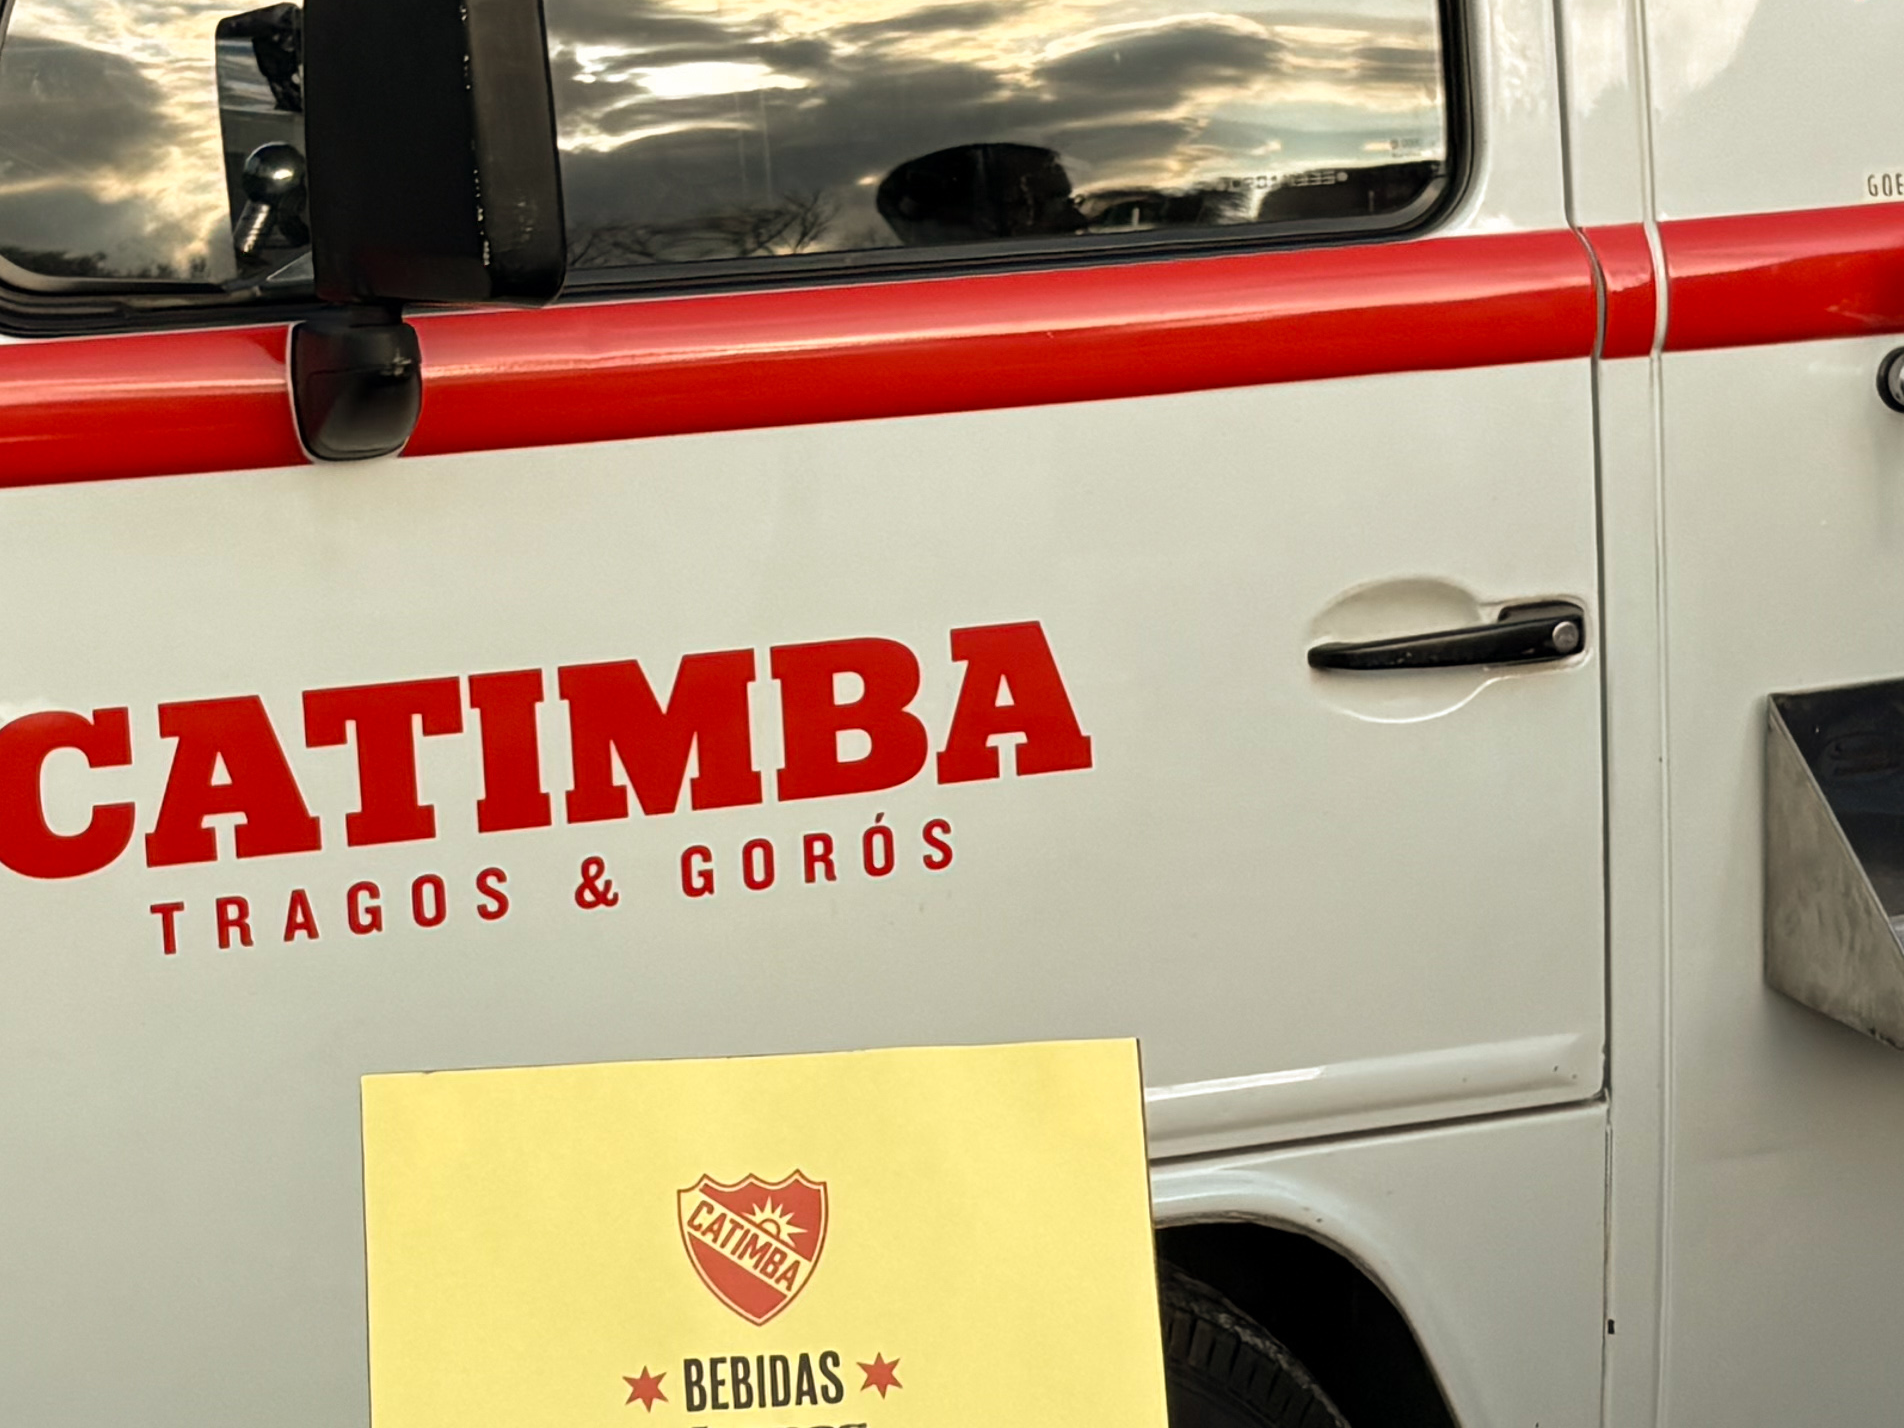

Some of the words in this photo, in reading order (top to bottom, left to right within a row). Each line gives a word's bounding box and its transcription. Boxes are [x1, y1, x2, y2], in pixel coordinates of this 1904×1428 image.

[149, 867, 515, 958] TRAGOS
[572, 855, 621, 912] &
[679, 811, 956, 901] GORÓS
[686, 1198, 802, 1293] CATIMBA
[683, 1349, 845, 1412] BEBIDAS
